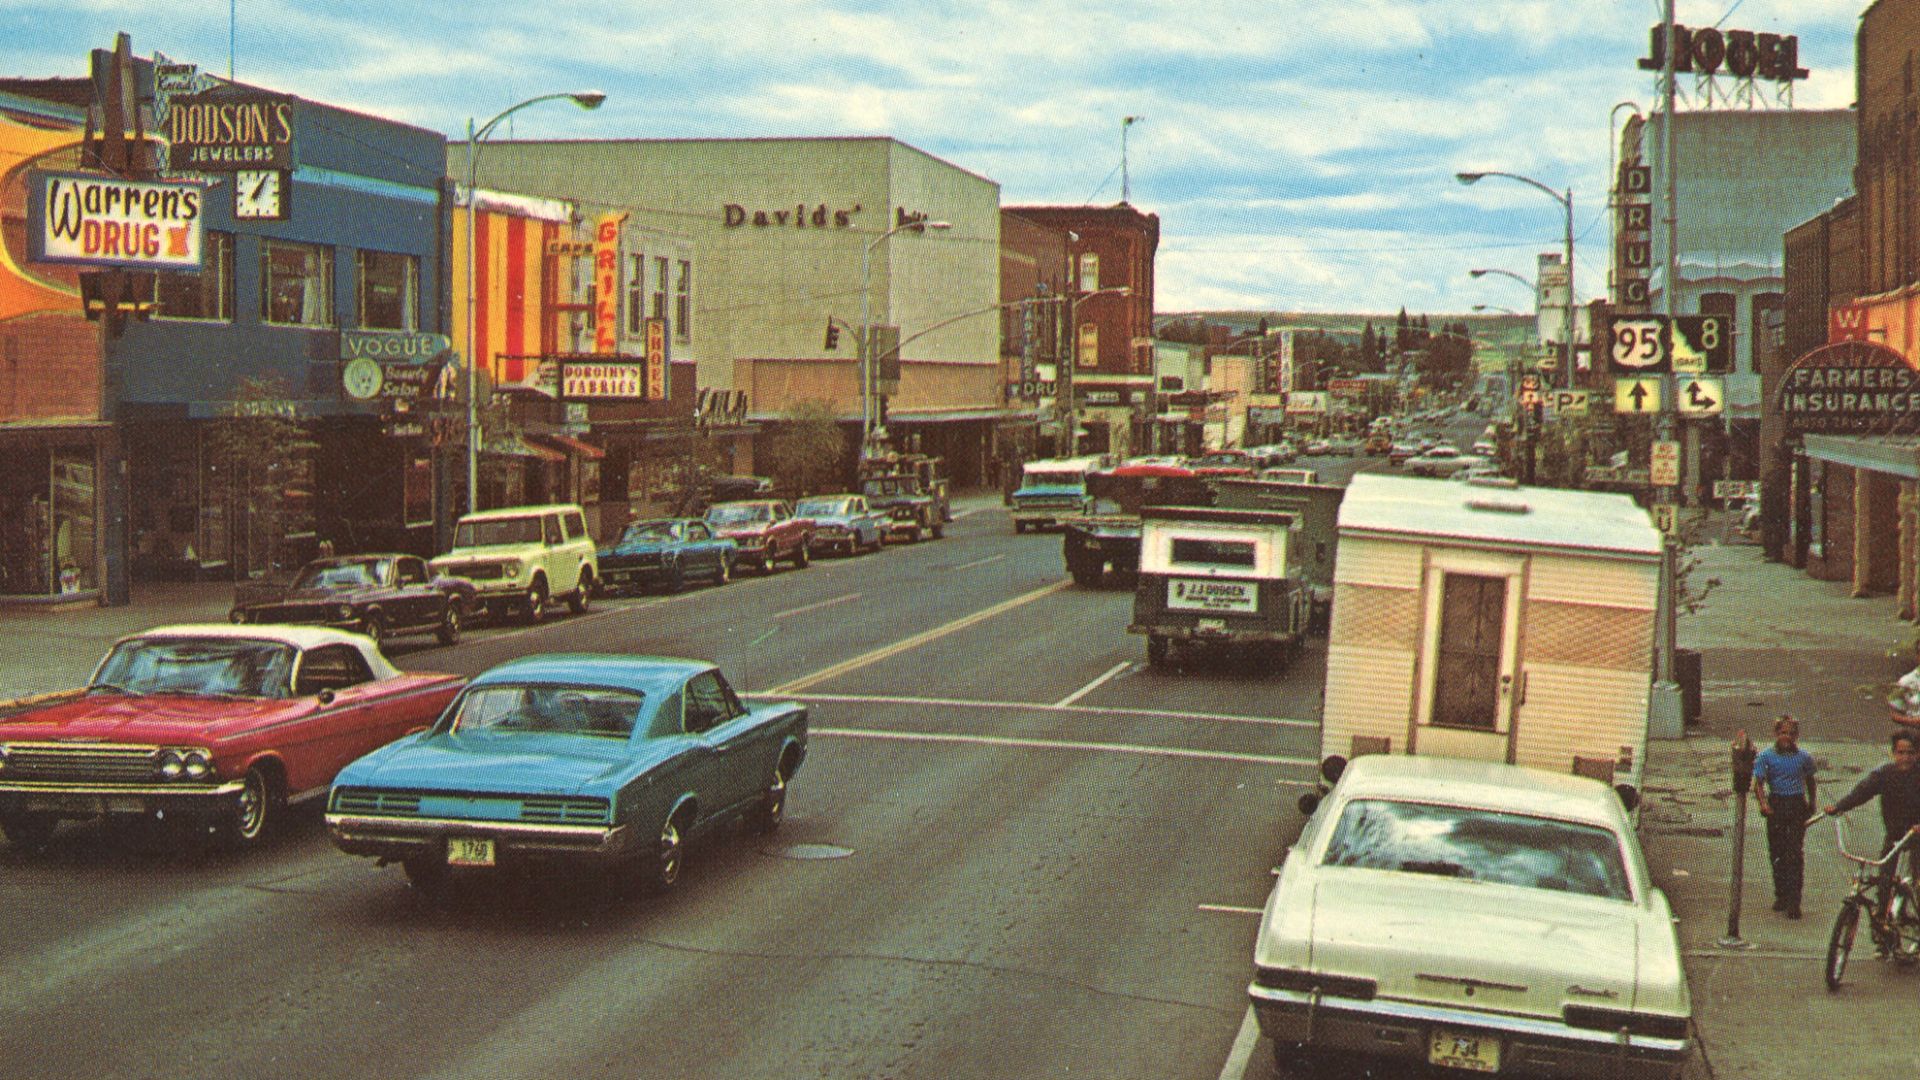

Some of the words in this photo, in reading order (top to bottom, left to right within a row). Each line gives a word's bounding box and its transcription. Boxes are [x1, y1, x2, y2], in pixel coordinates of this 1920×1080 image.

[171, 101, 292, 144] DODSON'S
[190, 146, 275, 161] JEWELERS
[50, 178, 198, 241] Warren's
[83, 219, 160, 256] DRUG
[1627, 172, 1646, 300] DRUG
[349, 337, 433, 356] VOGUE
[1618, 327, 1658, 359] 95
[1701, 317, 1719, 349] 8
[651, 322, 662, 398] SHOES
[568, 380, 636, 394] FABRICS
[1795, 367, 1911, 388] FARMERS
[1783, 392, 1920, 412] INSURANCE
